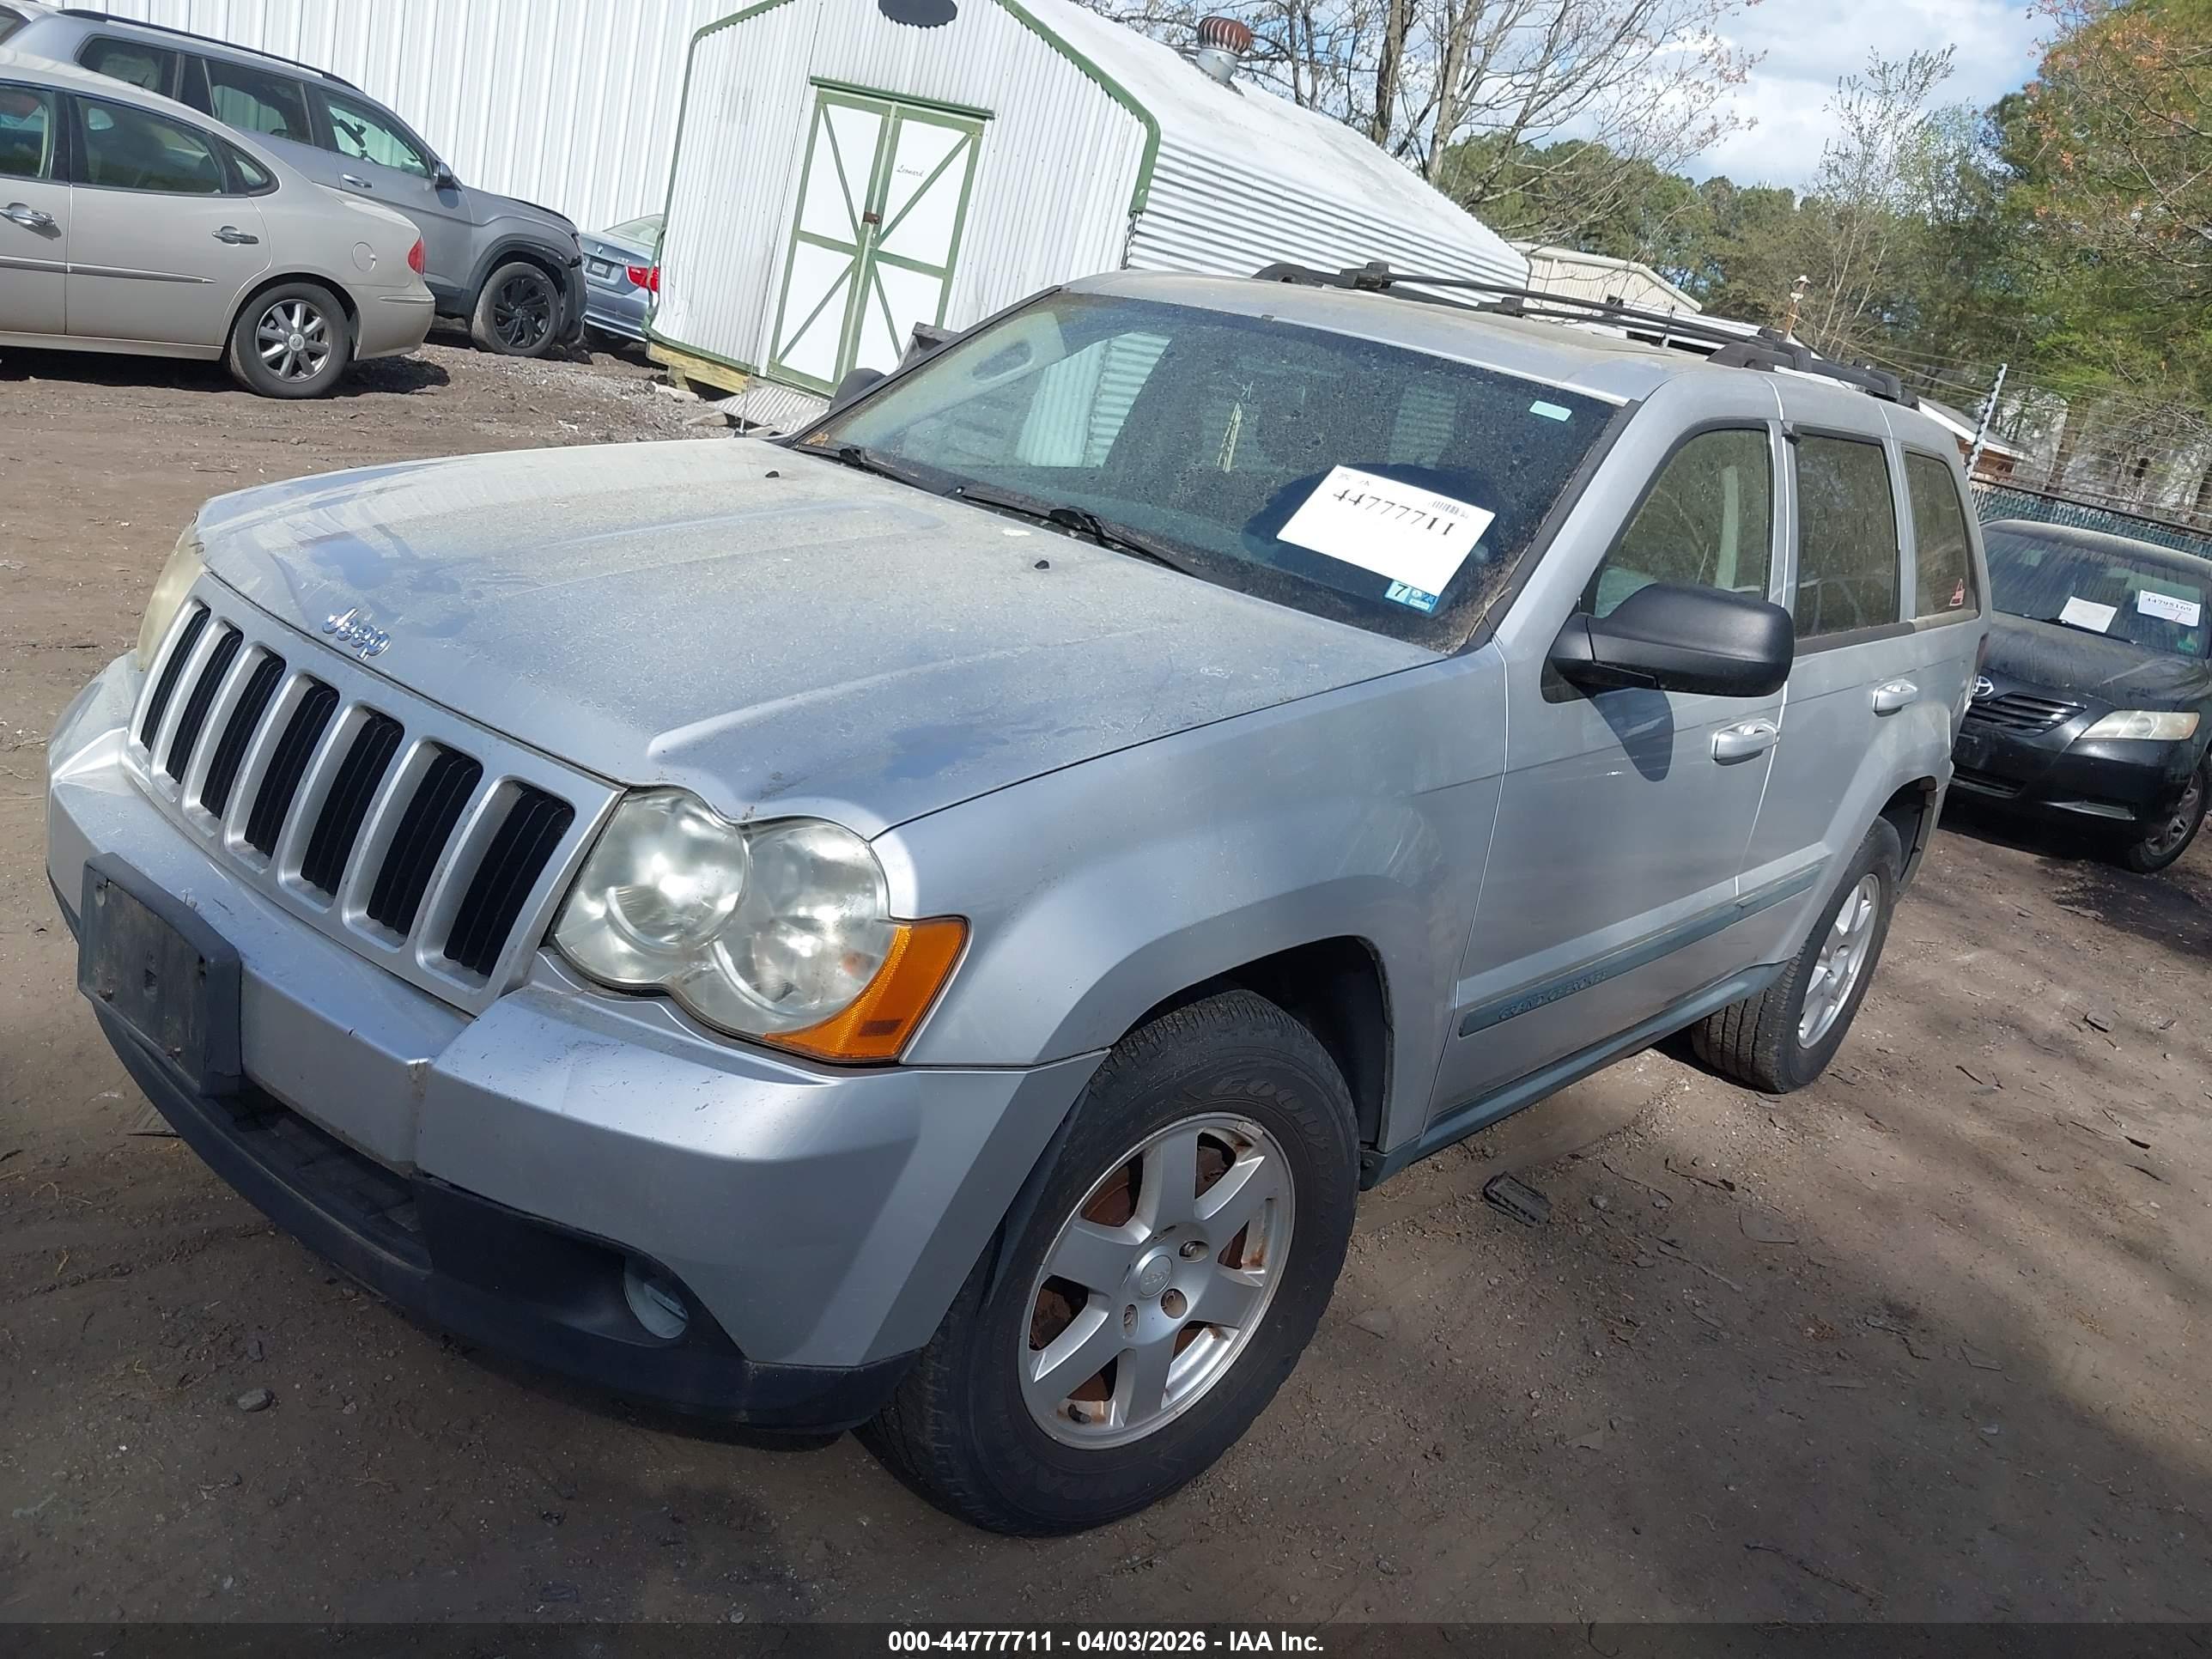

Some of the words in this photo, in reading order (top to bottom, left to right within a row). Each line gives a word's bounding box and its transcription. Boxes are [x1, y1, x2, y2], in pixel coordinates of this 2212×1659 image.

[1333, 489, 1455, 536] 44777711
[1395, 584, 1409, 597] 7
[322, 606, 392, 660] Jeep
